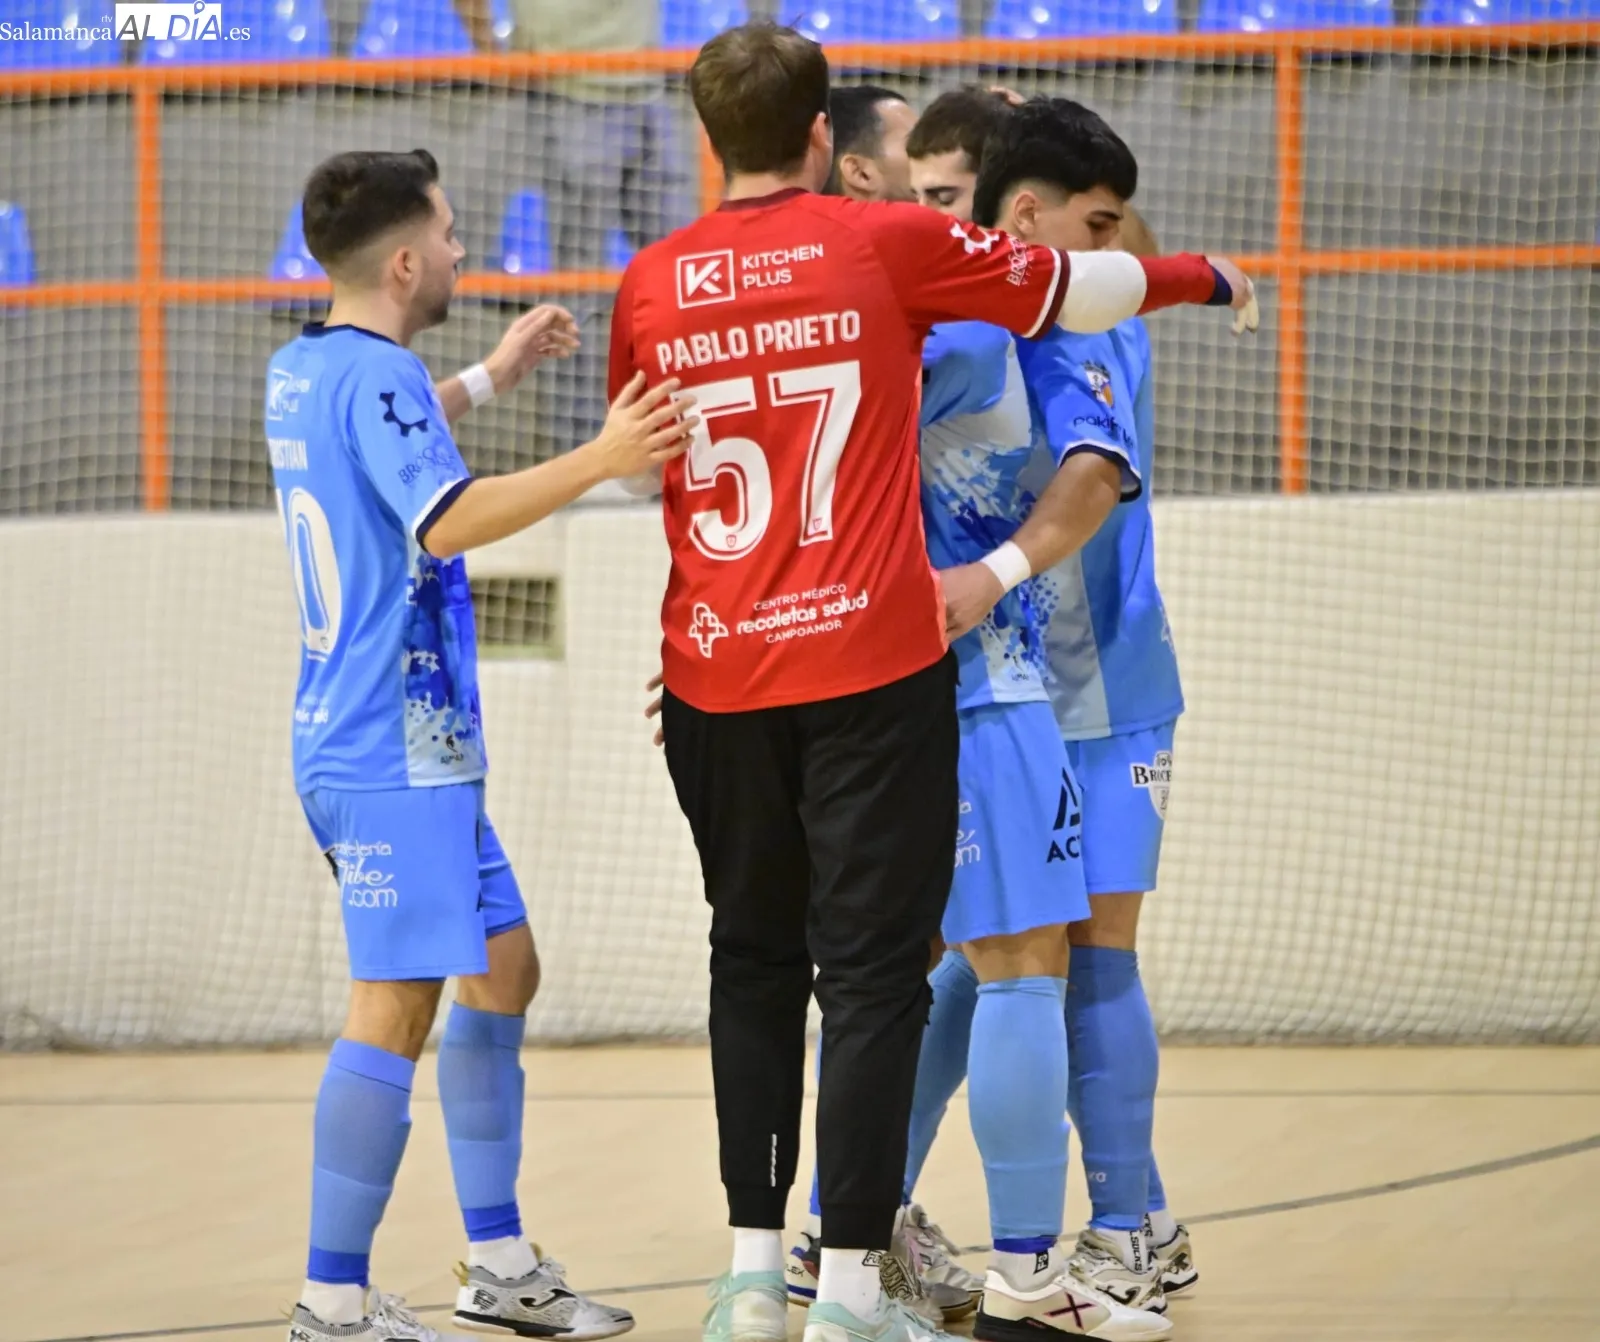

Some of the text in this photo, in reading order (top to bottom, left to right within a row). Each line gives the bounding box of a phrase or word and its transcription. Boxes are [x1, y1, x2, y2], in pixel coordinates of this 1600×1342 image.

[741, 243, 824, 271] KITCHEN
[742, 267, 793, 290] PLUS
[655, 309, 861, 376] PABLO PRIETO
[670, 359, 862, 562] 57
[736, 588, 869, 635] recoletas salud
[753, 583, 847, 612] CENTRO MÉDICO
[765, 619, 843, 644] CAMPOAMOR
[1046, 834, 1081, 863] AC
